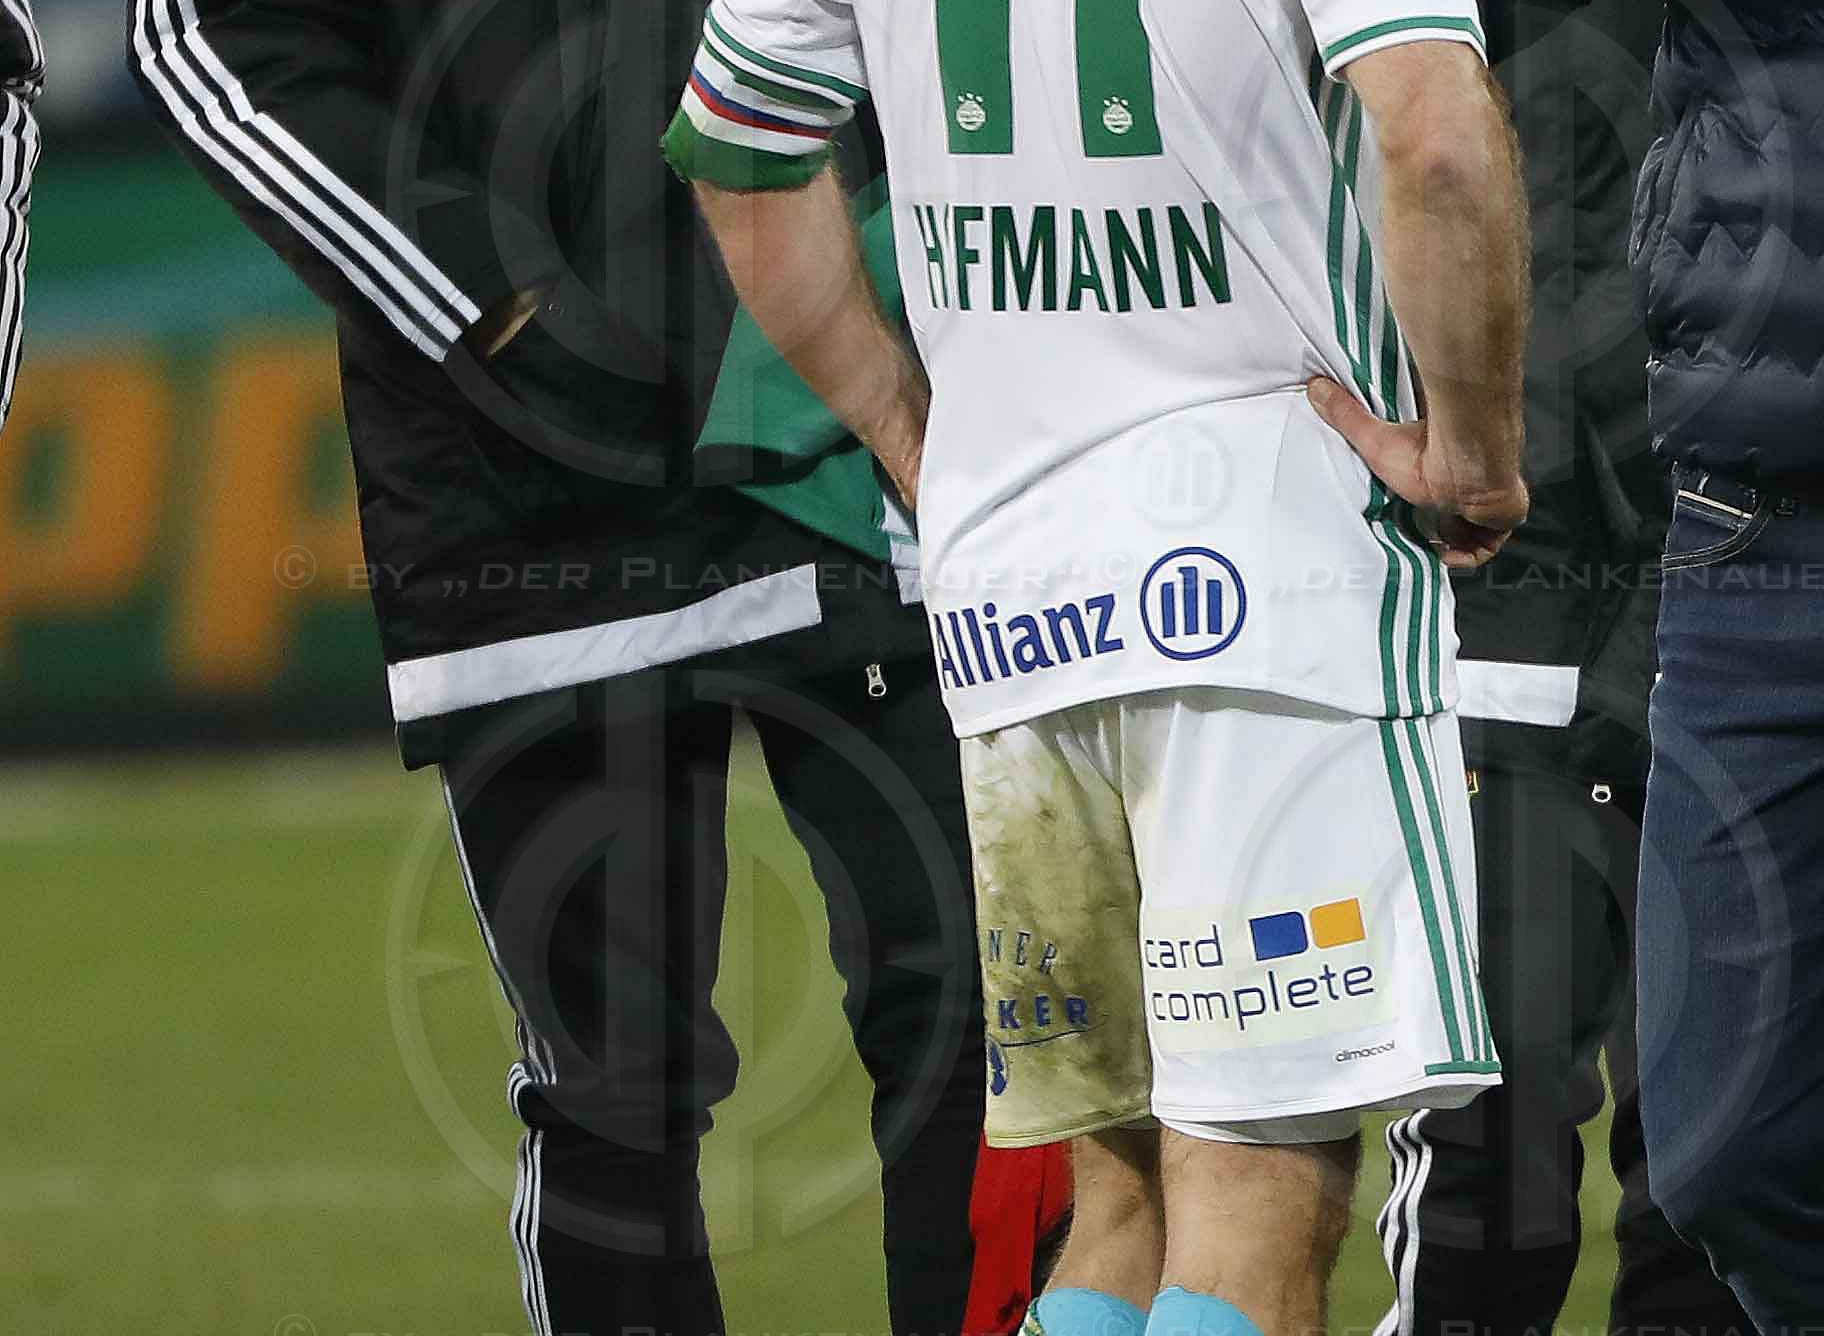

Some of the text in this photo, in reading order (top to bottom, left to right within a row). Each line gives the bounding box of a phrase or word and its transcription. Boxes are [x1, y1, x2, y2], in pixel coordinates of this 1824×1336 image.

[913, 200, 1233, 313] HFMANN
[932, 593, 1126, 690] Allianz
[988, 928, 1058, 976] NER
[1144, 924, 1224, 969] card
[997, 993, 1090, 1031] KER
[1152, 963, 1376, 1032] complete
